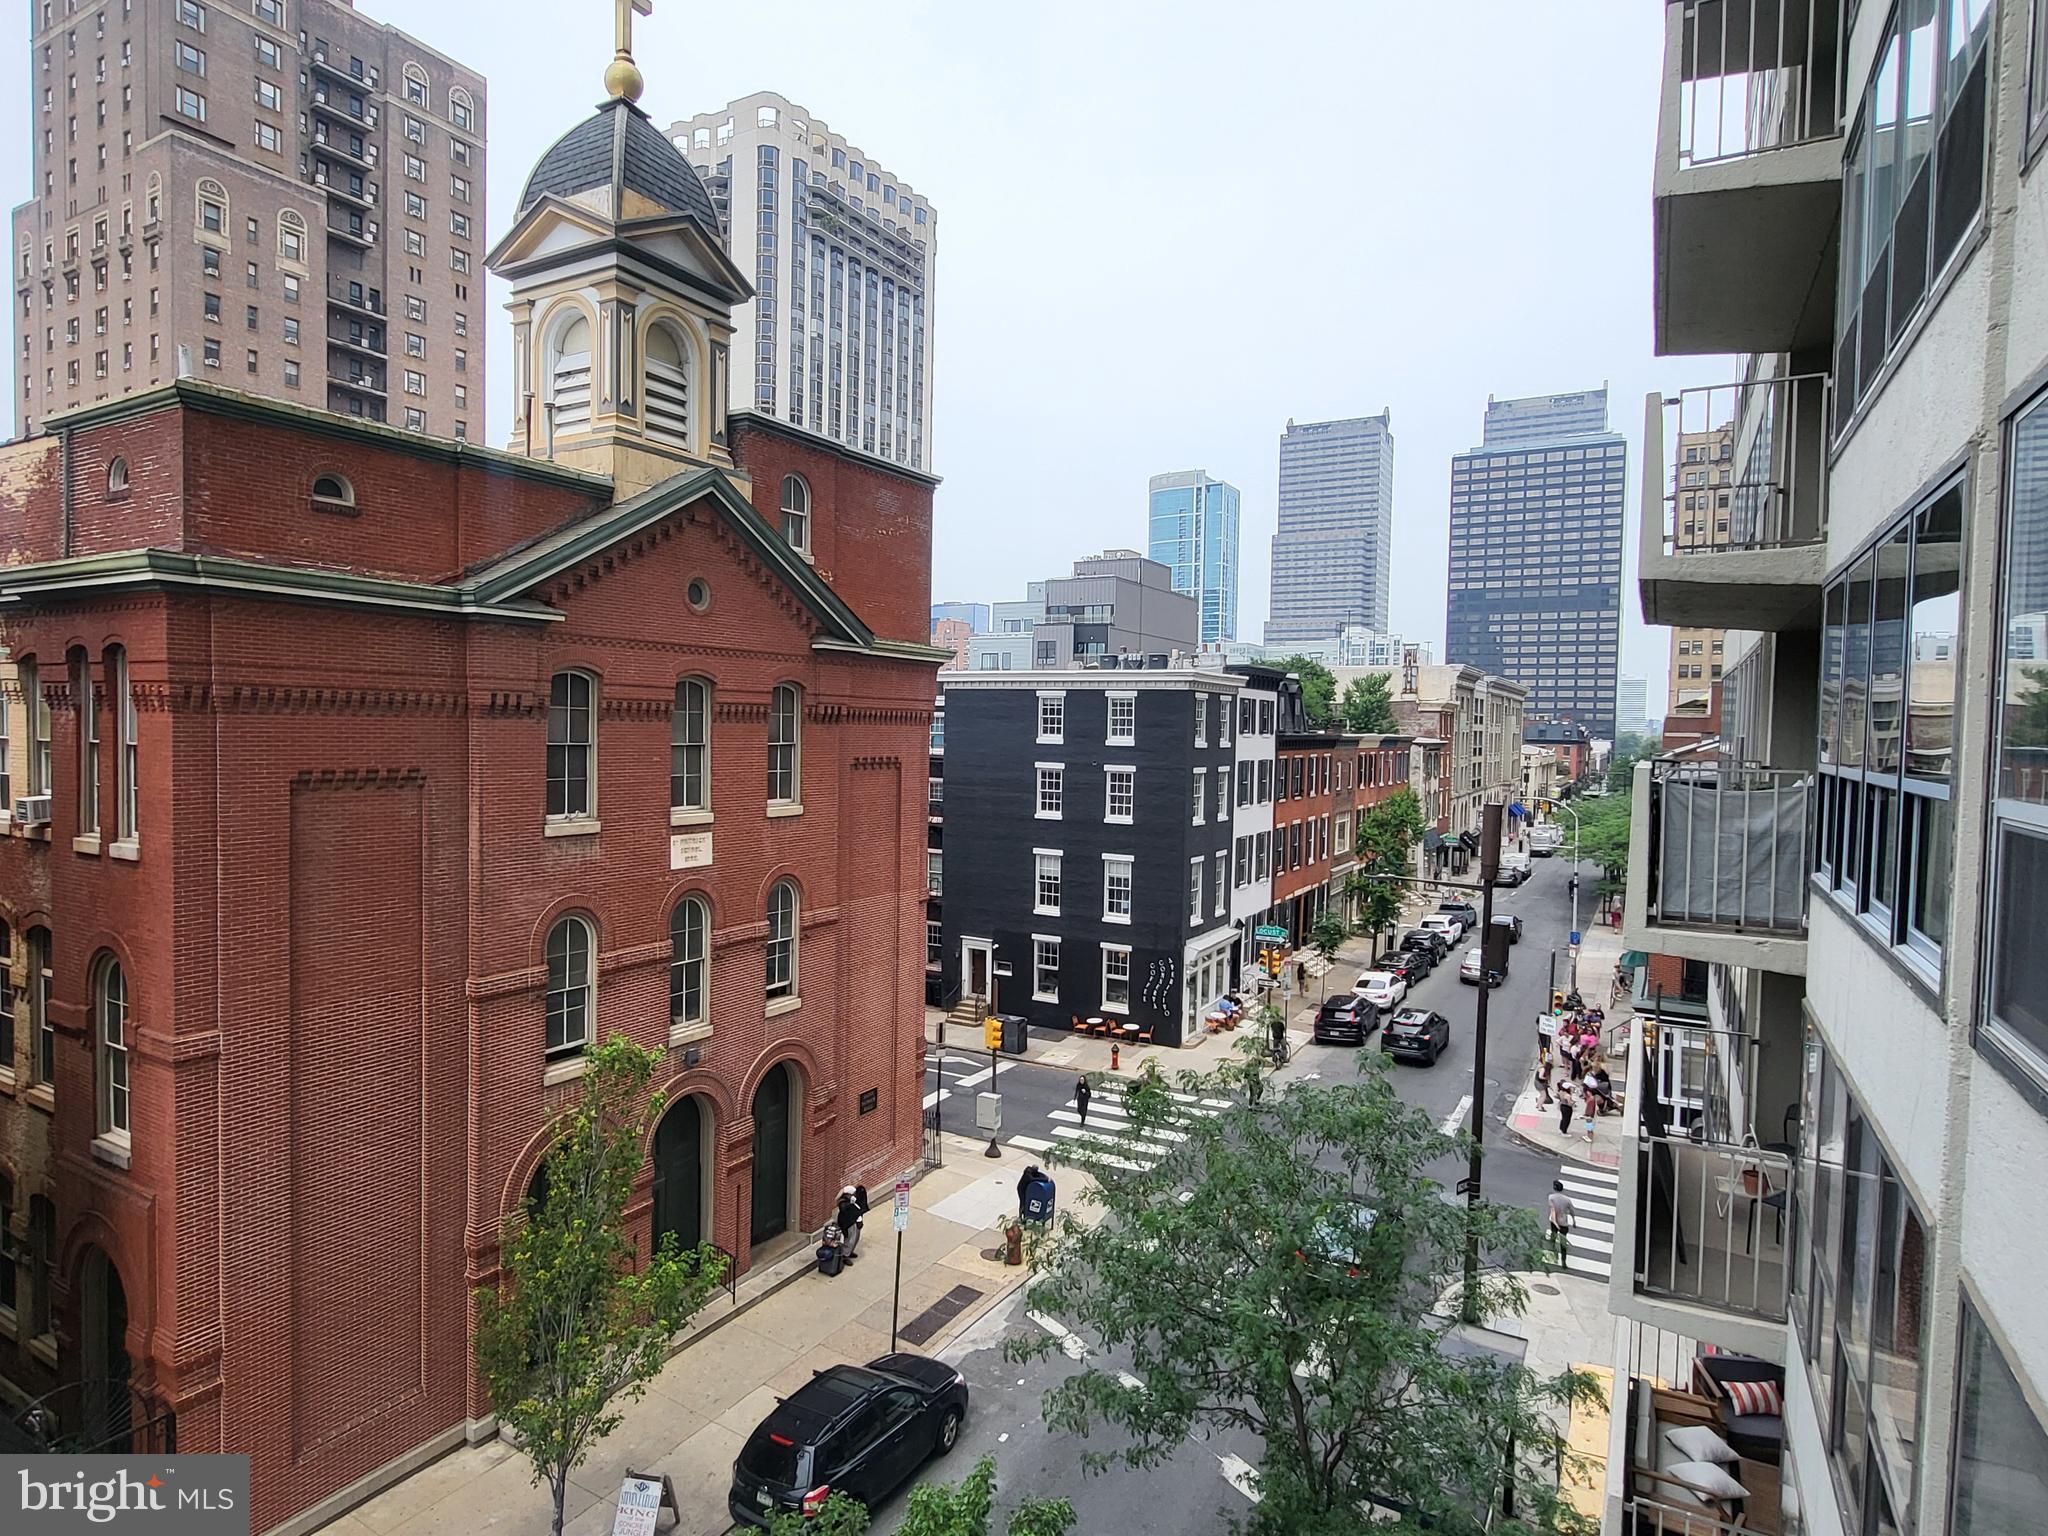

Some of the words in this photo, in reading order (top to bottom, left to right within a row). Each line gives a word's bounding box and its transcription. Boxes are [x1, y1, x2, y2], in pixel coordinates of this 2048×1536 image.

[1256, 928, 1280, 936] LOCUST
[1143, 963, 1156, 1002] COFFEE
[1162, 957, 1174, 1017] APERITIVO
[618, 1507, 656, 1518] KING
